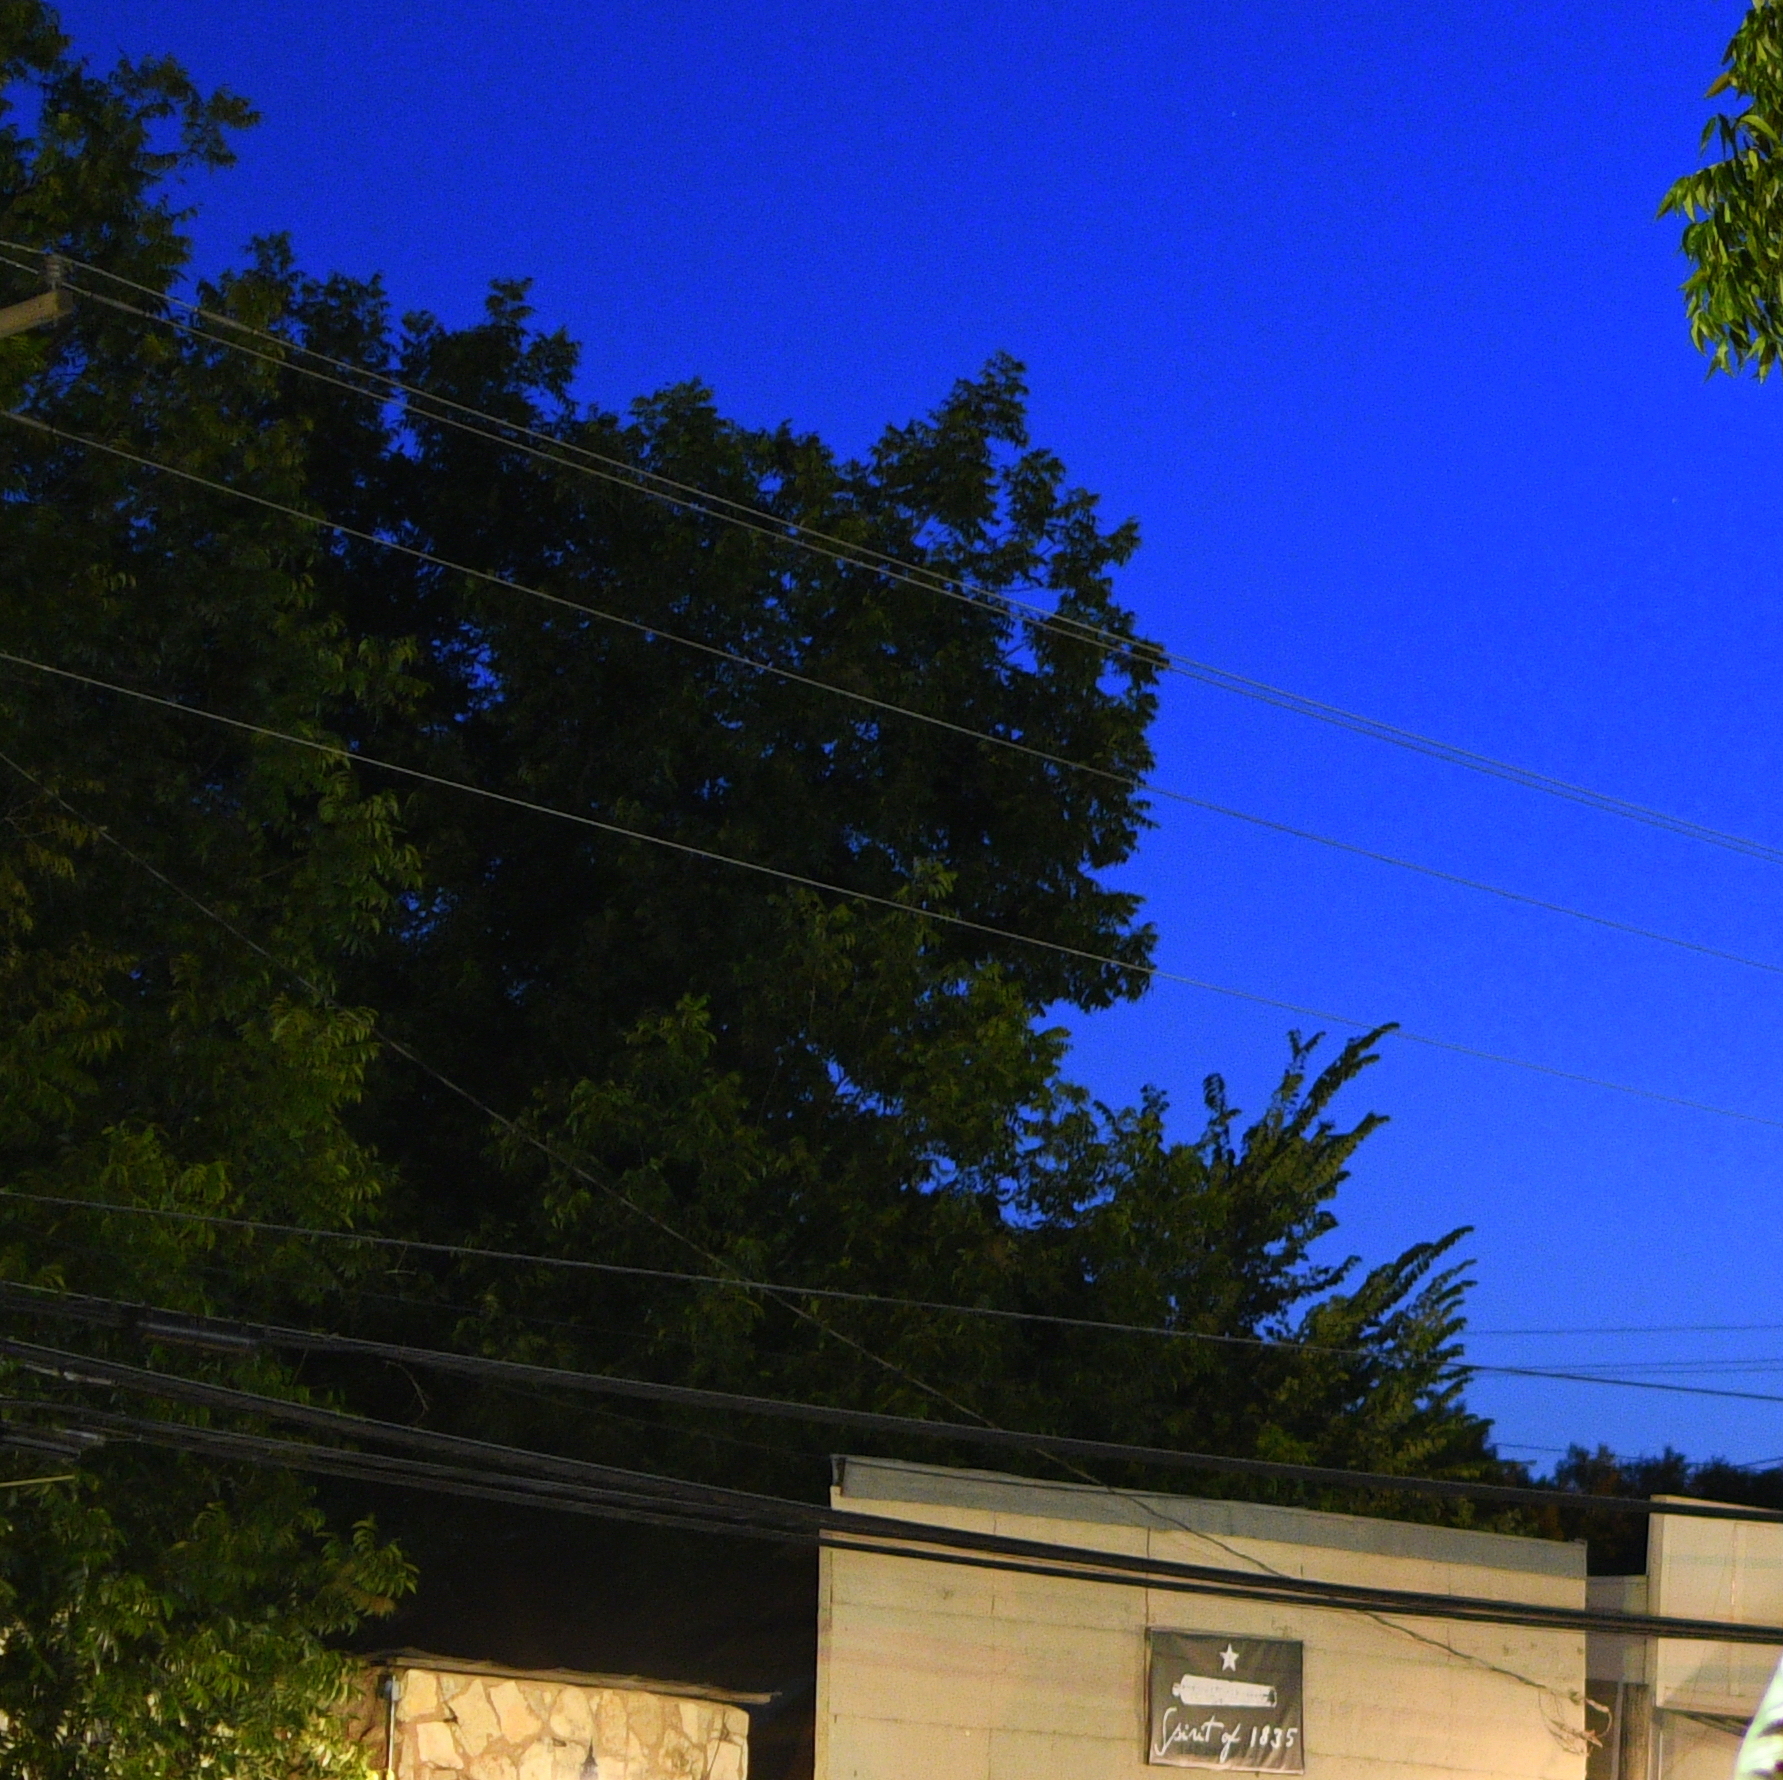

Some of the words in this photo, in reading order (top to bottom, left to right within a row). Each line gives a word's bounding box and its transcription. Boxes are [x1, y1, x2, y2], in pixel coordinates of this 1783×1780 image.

[1154, 1707, 1225, 1756] Spirit
[1220, 1723, 1241, 1763] of
[1249, 1727, 1299, 1749] 1835
